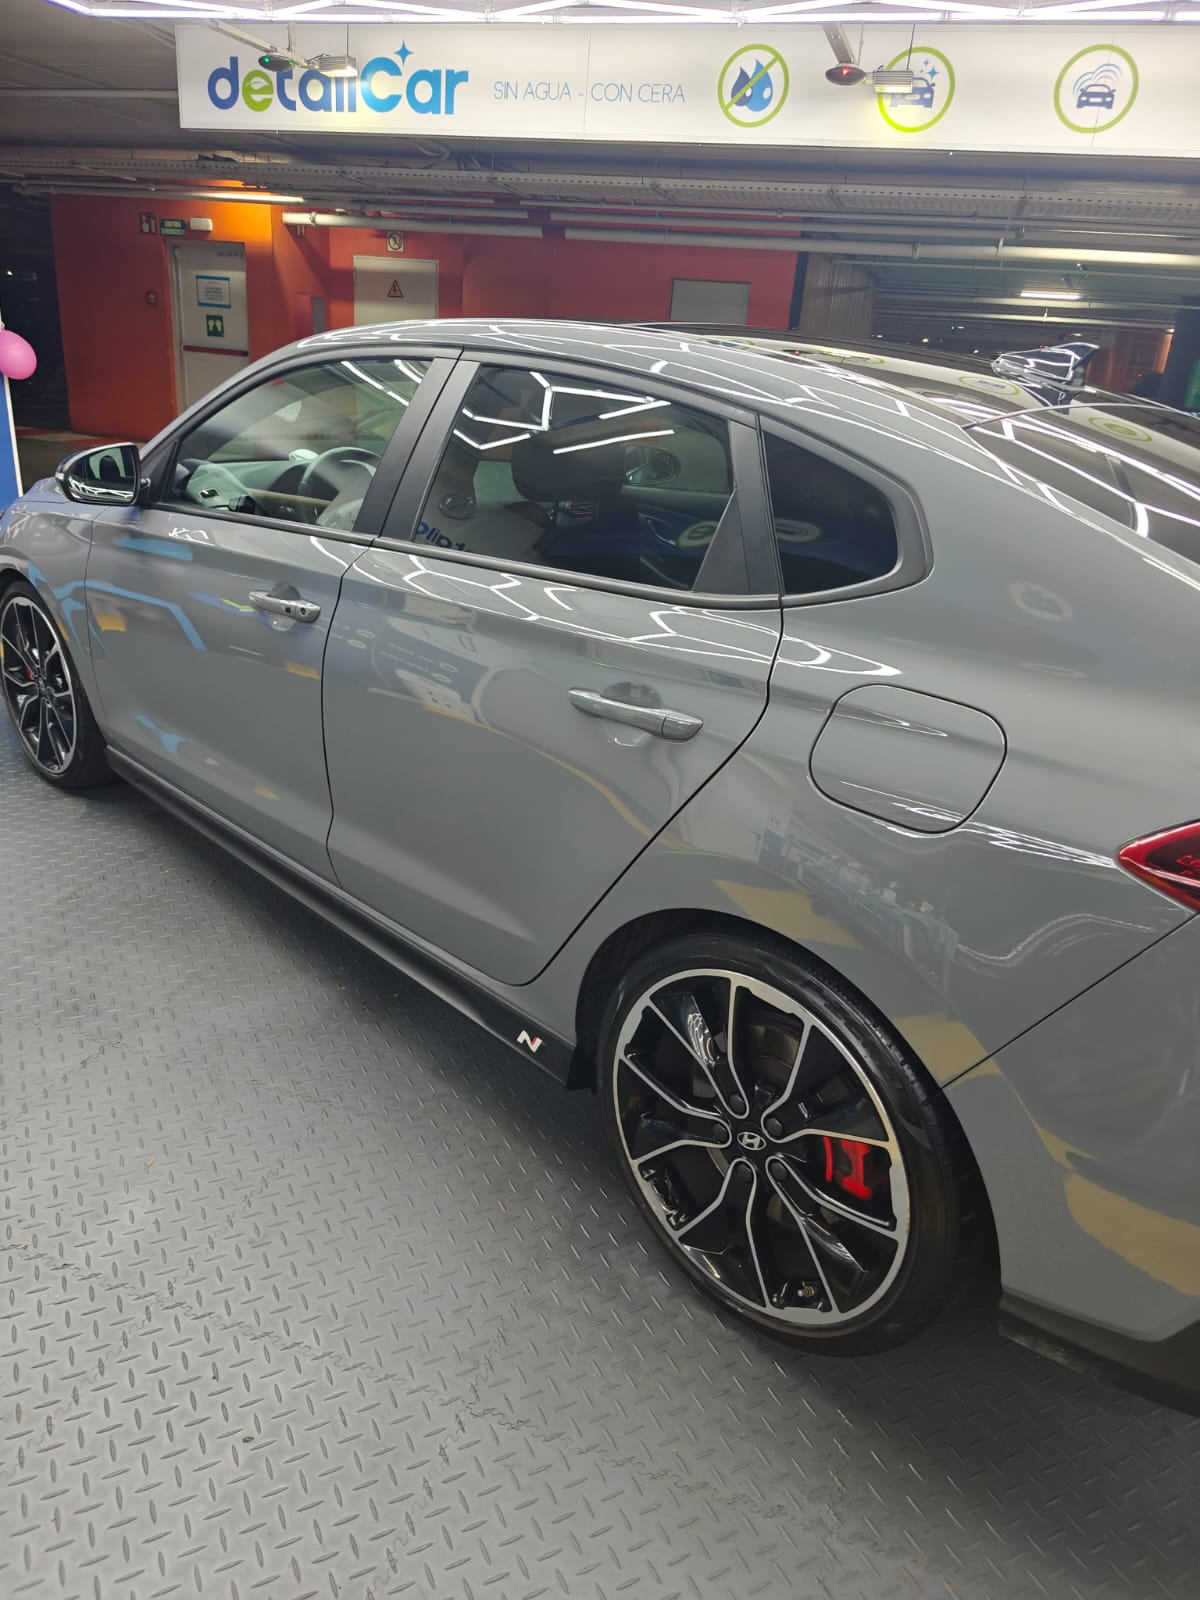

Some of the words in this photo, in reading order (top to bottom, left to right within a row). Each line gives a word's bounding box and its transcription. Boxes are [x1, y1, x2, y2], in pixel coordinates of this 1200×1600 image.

[207, 56, 469, 115] detailCar
[493, 81, 518, 100] SIN
[522, 82, 572, 101] AGUA
[590, 82, 633, 102] CON
[637, 83, 686, 103] CERA
